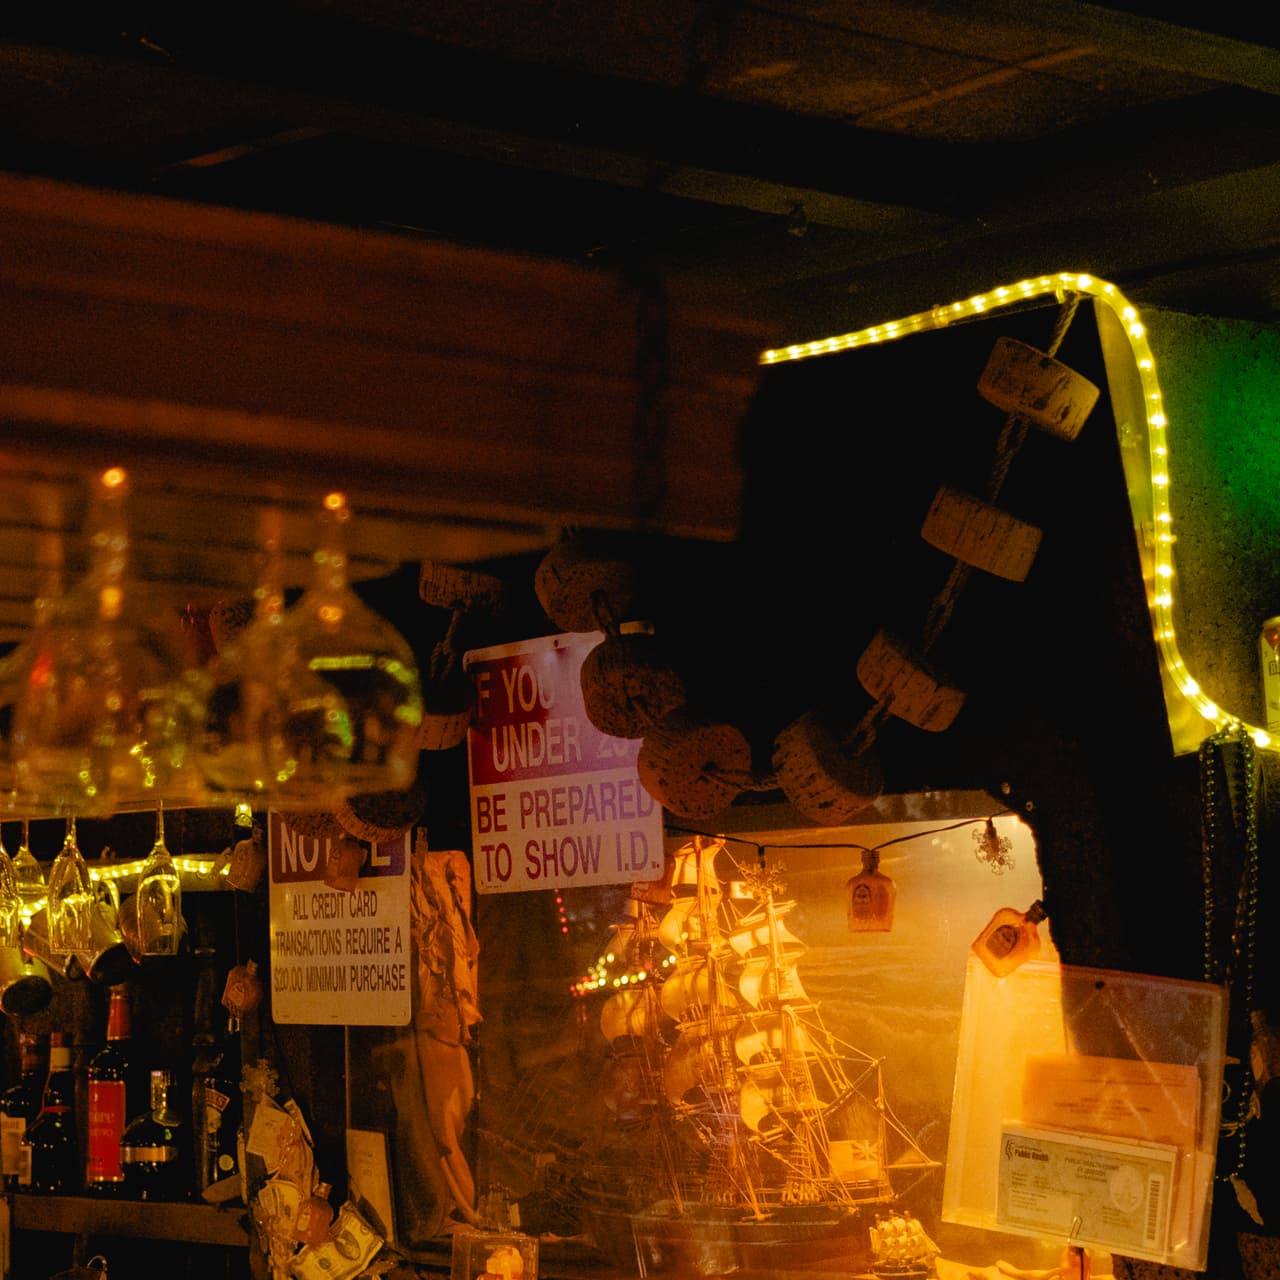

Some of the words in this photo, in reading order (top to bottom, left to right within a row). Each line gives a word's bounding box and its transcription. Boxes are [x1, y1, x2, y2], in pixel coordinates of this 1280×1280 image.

[492, 717, 581, 772] UNDER
[477, 794, 507, 834] BE
[520, 779, 655, 830] PREPARED
[481, 842, 512, 882] TO
[525, 833, 602, 880] SHOW
[293, 893, 309, 920] ALL
[311, 891, 346, 919] CREDIT
[349, 889, 378, 918] CARD
[275, 927, 342, 956] TRANSACTIONS
[345, 926, 391, 955] REQUIRE
[394, 926, 403, 953] A
[273, 965, 303, 993] $20.00
[306, 964, 347, 993] MINIMUM
[350, 963, 406, 992] PURCHASE
